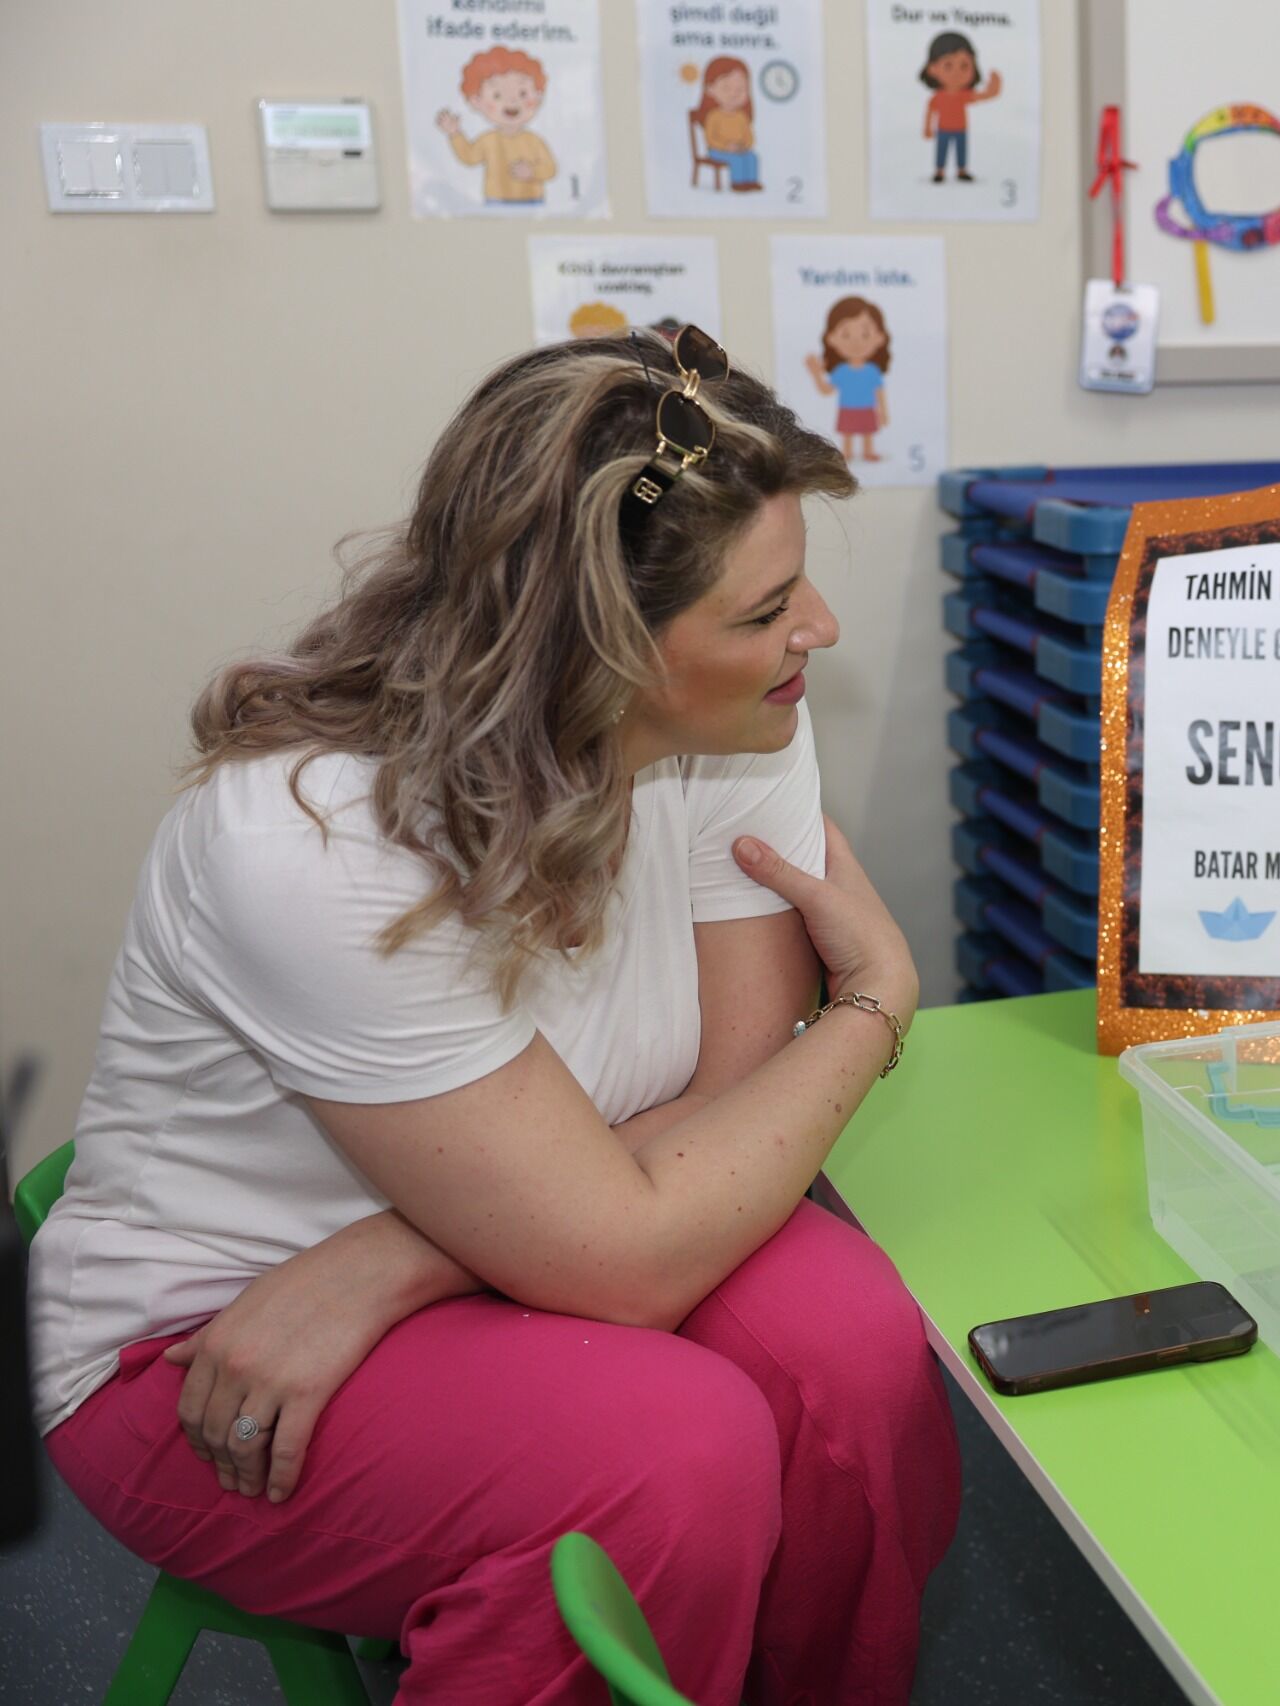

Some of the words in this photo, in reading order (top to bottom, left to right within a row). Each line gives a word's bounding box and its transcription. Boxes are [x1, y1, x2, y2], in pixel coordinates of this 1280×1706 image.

[427, 16, 484, 38] ifade
[673, 31, 715, 47] ama
[570, 174, 581, 197] 1
[785, 175, 804, 204] 2
[1001, 178, 1018, 209] 3
[798, 265, 871, 287] Yardım
[907, 444, 926, 473] 5
[1185, 564, 1272, 601] TAHMİN
[1168, 627, 1267, 659] DENEYLE
[1194, 850, 1258, 879] BATAR
